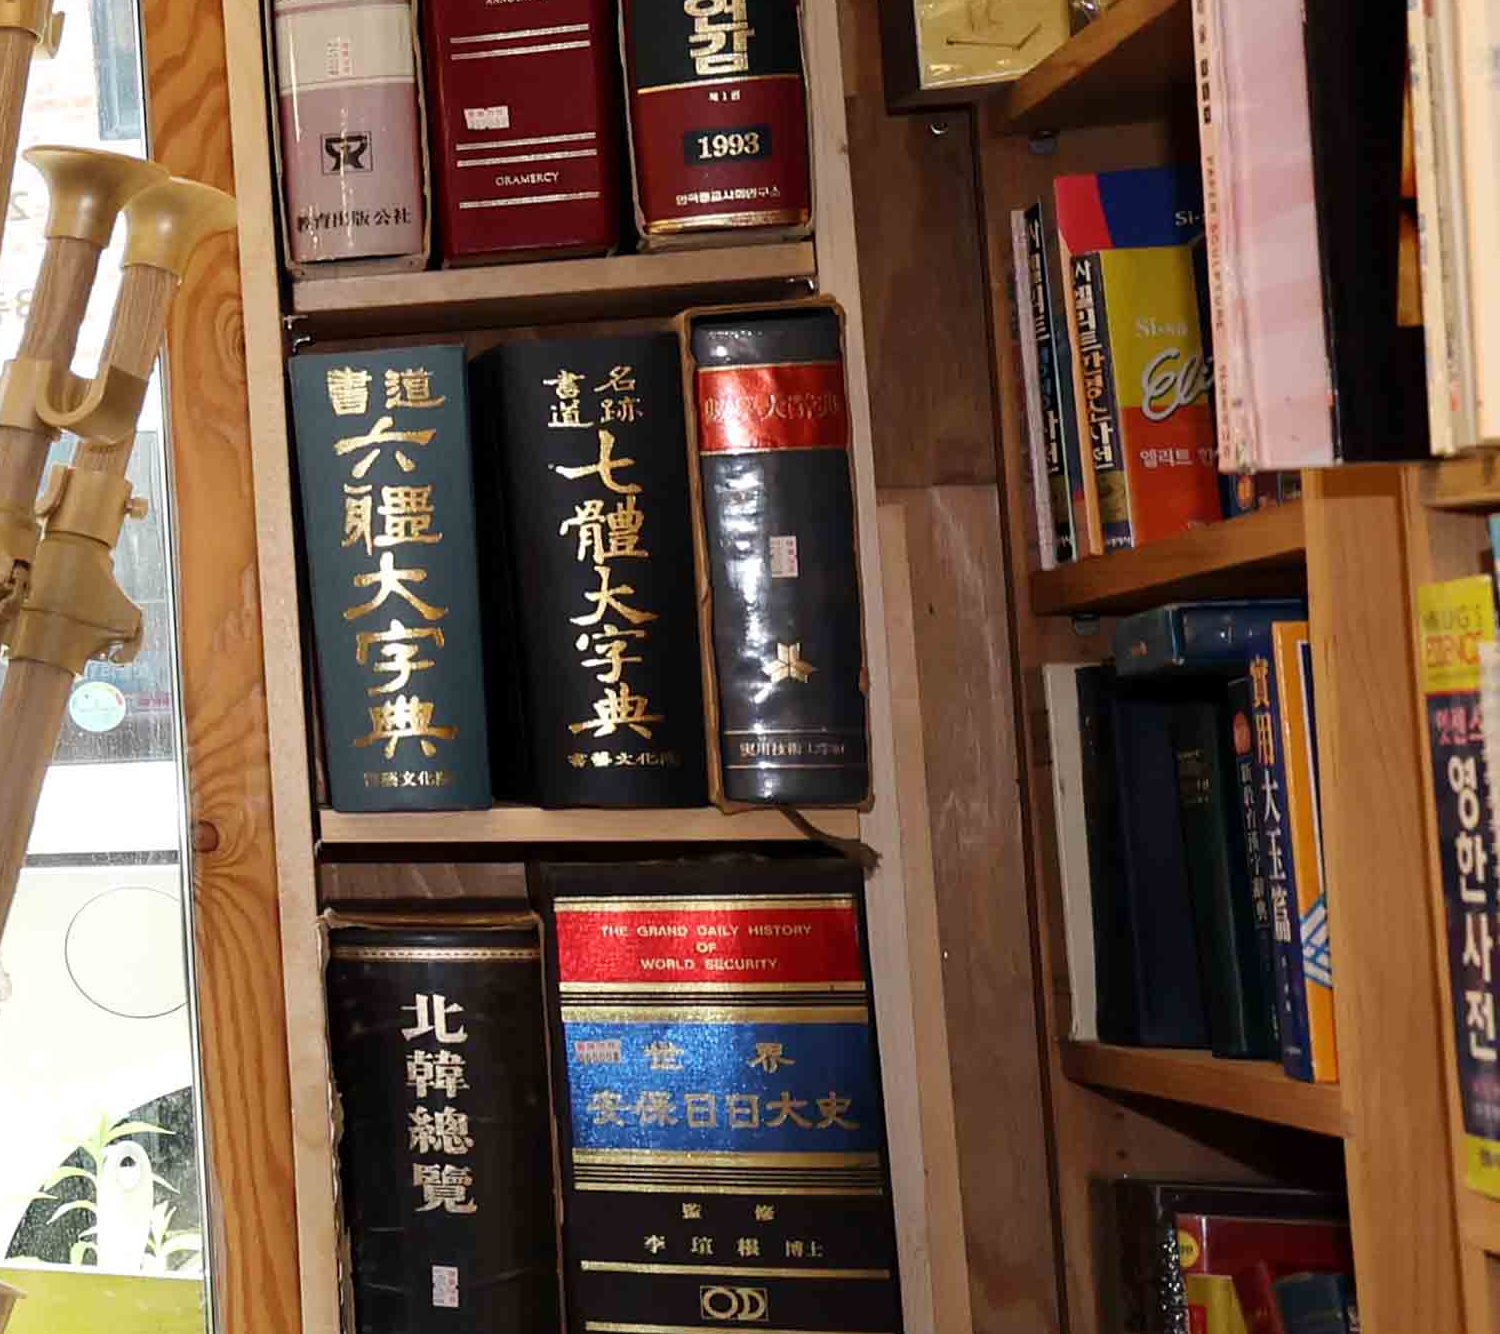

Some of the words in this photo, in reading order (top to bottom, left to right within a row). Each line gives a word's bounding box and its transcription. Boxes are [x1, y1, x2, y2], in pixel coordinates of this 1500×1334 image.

[696, 130, 762, 161] 1993
[494, 170, 560, 187] GRAMERCY
[326, 366, 447, 417] 書道
[547, 428, 665, 741] 七體大字典
[1446, 753, 1498, 1063] 영한사전
[601, 924, 629, 938] THE
[636, 924, 688, 937] GRAND
[697, 923, 740, 938] DAILY
[748, 923, 813, 938] HISTORY
[696, 941, 717, 954] OF
[640, 957, 695, 971] WORLD
[702, 957, 779, 972] SECURITY
[643, 1039, 797, 1075] 世界
[400, 992, 479, 1216] 北韓總覽
